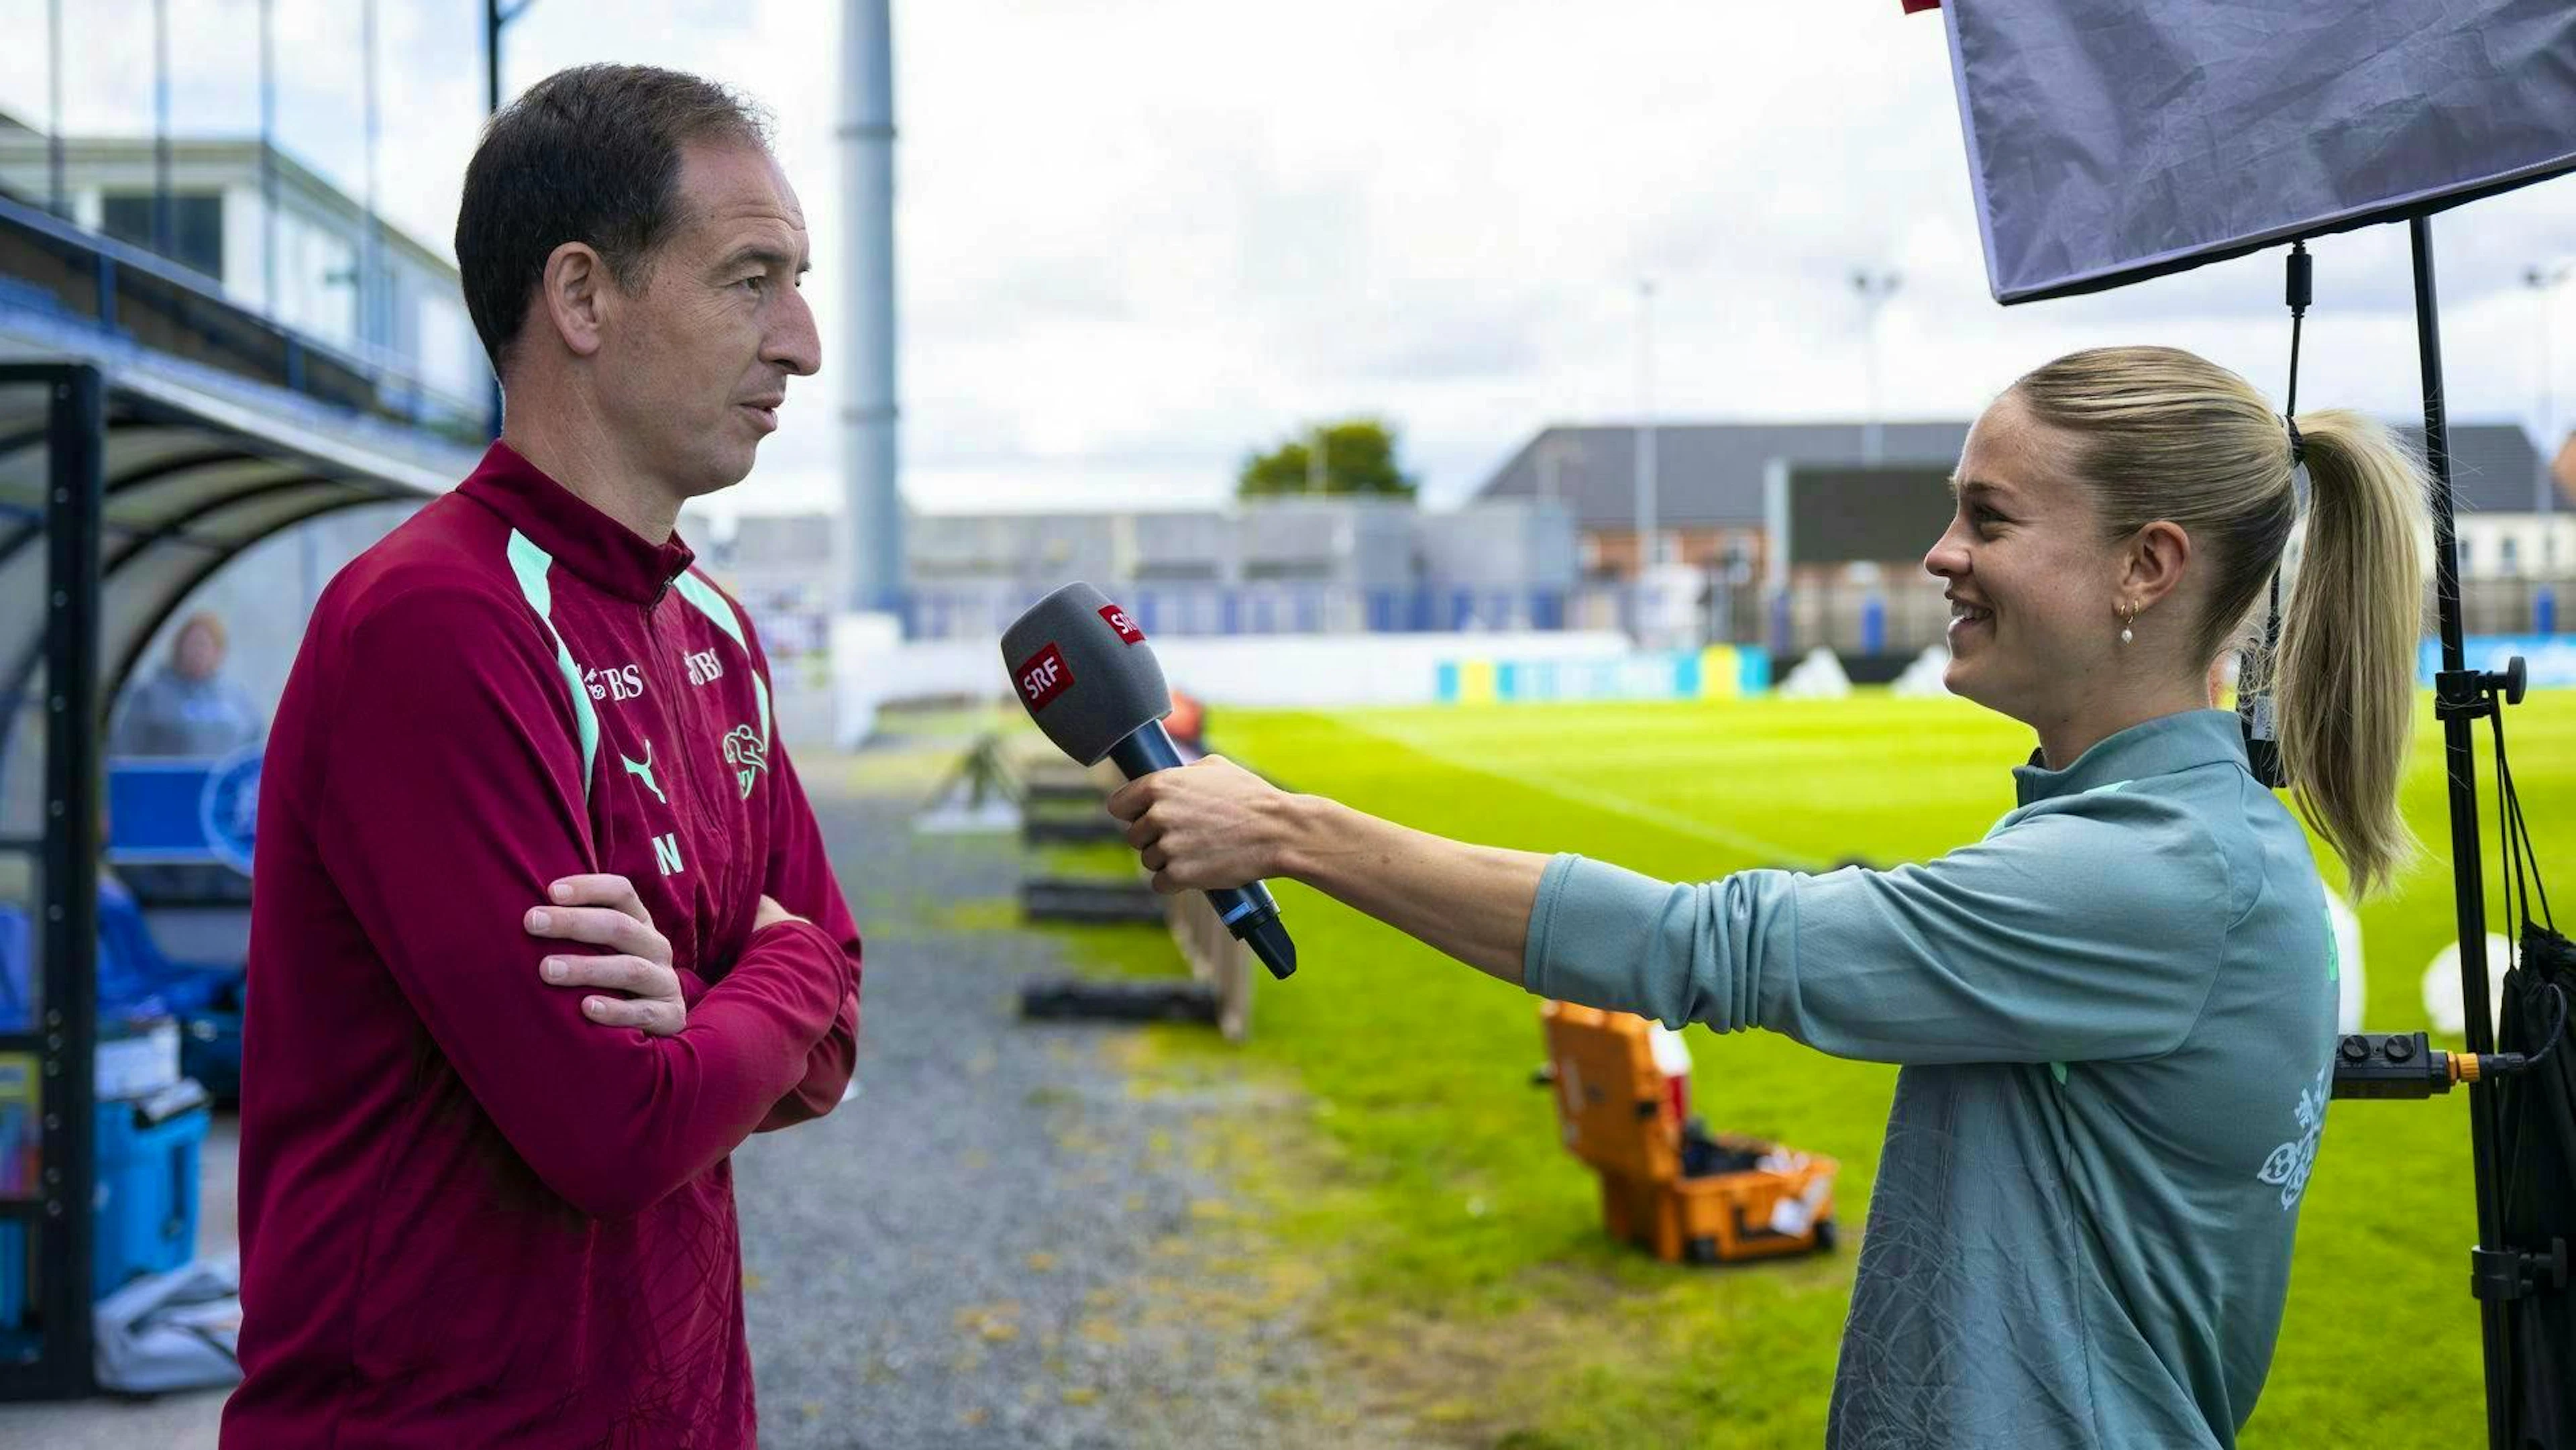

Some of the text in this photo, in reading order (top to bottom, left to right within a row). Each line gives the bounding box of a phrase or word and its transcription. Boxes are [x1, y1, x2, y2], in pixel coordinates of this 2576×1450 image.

[1111, 613, 1138, 634] SR
[599, 664, 643, 701] BS
[1024, 656, 1058, 699] SRF
